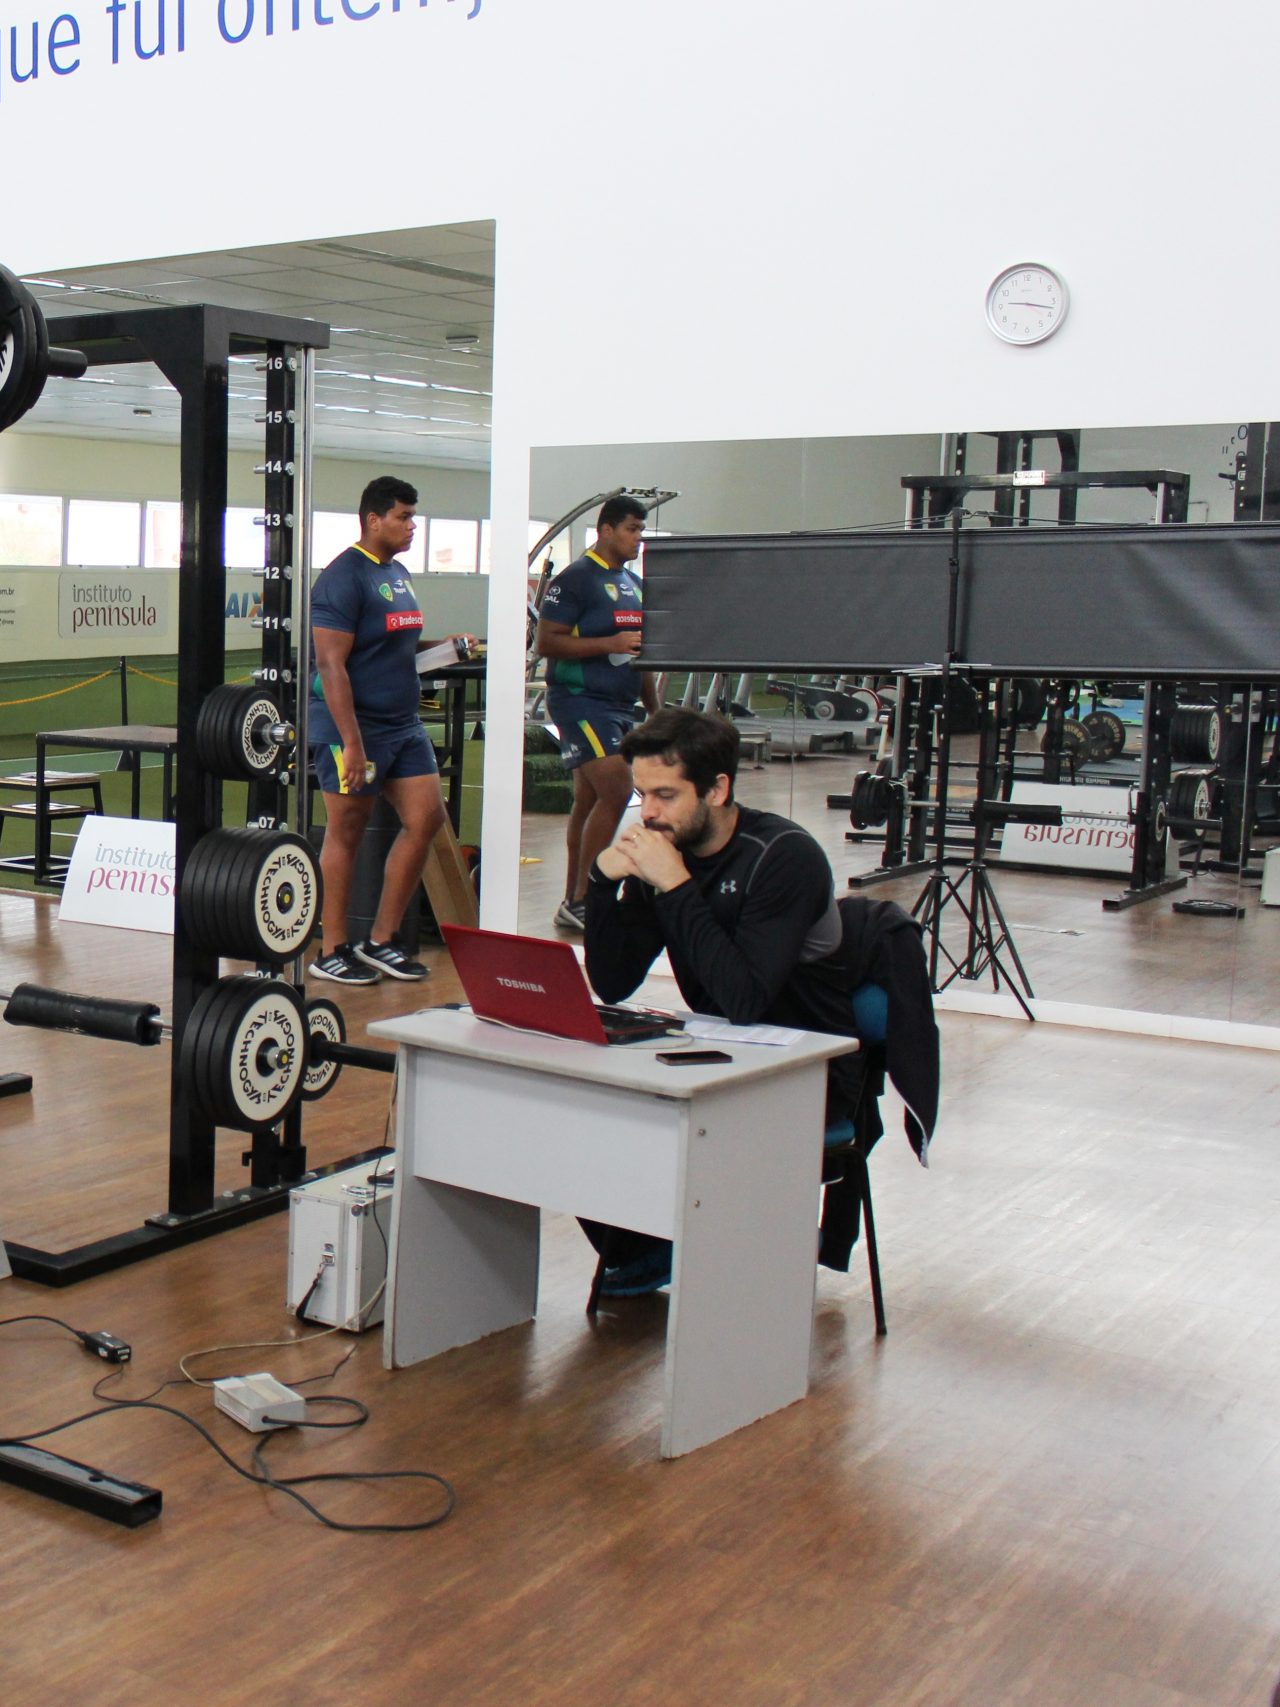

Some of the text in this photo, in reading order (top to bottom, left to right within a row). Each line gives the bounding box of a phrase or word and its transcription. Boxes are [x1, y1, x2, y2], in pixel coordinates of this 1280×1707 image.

[266, 358, 282, 370] 16
[266, 411, 282, 423] 15
[265, 462, 282, 474] 14
[265, 515, 281, 526] 13
[264, 567, 280, 579] 12
[72, 584, 132, 603] instituto
[263, 616, 279, 630] 11
[261, 669, 278, 681] 10
[258, 816, 276, 829] 07
[261, 856, 286, 941] TECHNOGYM
[286, 853, 311, 938] TECHNOGYM
[496, 976, 547, 994] TOSHIBA
[239, 1010, 268, 1104] TECHNOGYM
